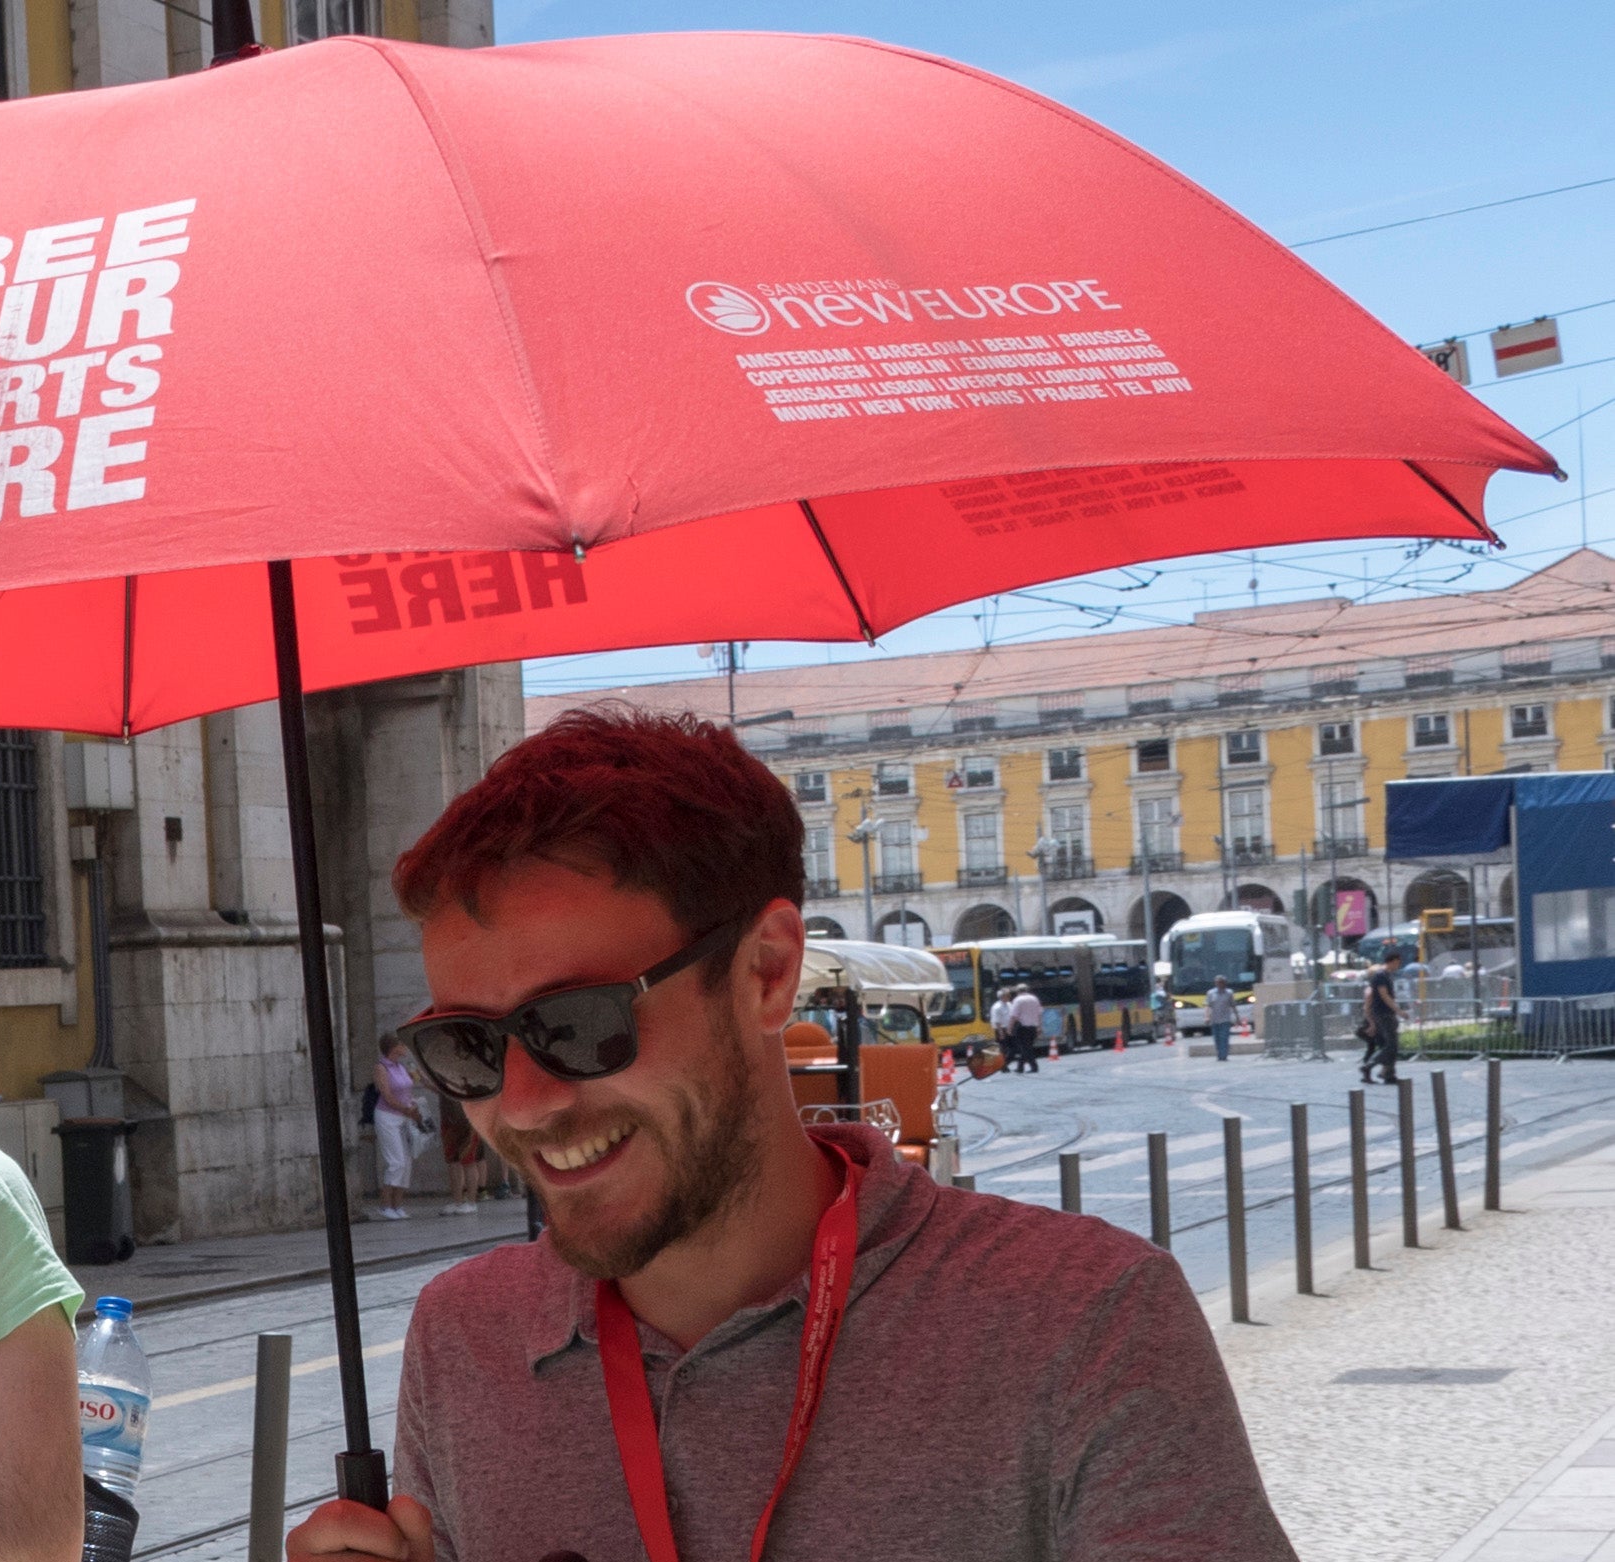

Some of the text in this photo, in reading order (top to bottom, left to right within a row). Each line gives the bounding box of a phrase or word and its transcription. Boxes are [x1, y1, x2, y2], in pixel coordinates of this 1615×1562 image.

[735, 327, 1151, 370] AMSTERDAM BARCELONA BERLIN BRUSSELS
[746, 344, 1166, 387] COPENHAGEN DUBLIN EDINBURGH HAMBURG
[764, 361, 1180, 405] JERUSALEM LISBON LIVERPOOL LONDON MADRID
[771, 376, 1194, 423] MUNICH NEW YORK PARIS PRAGUE TEL AVIV
